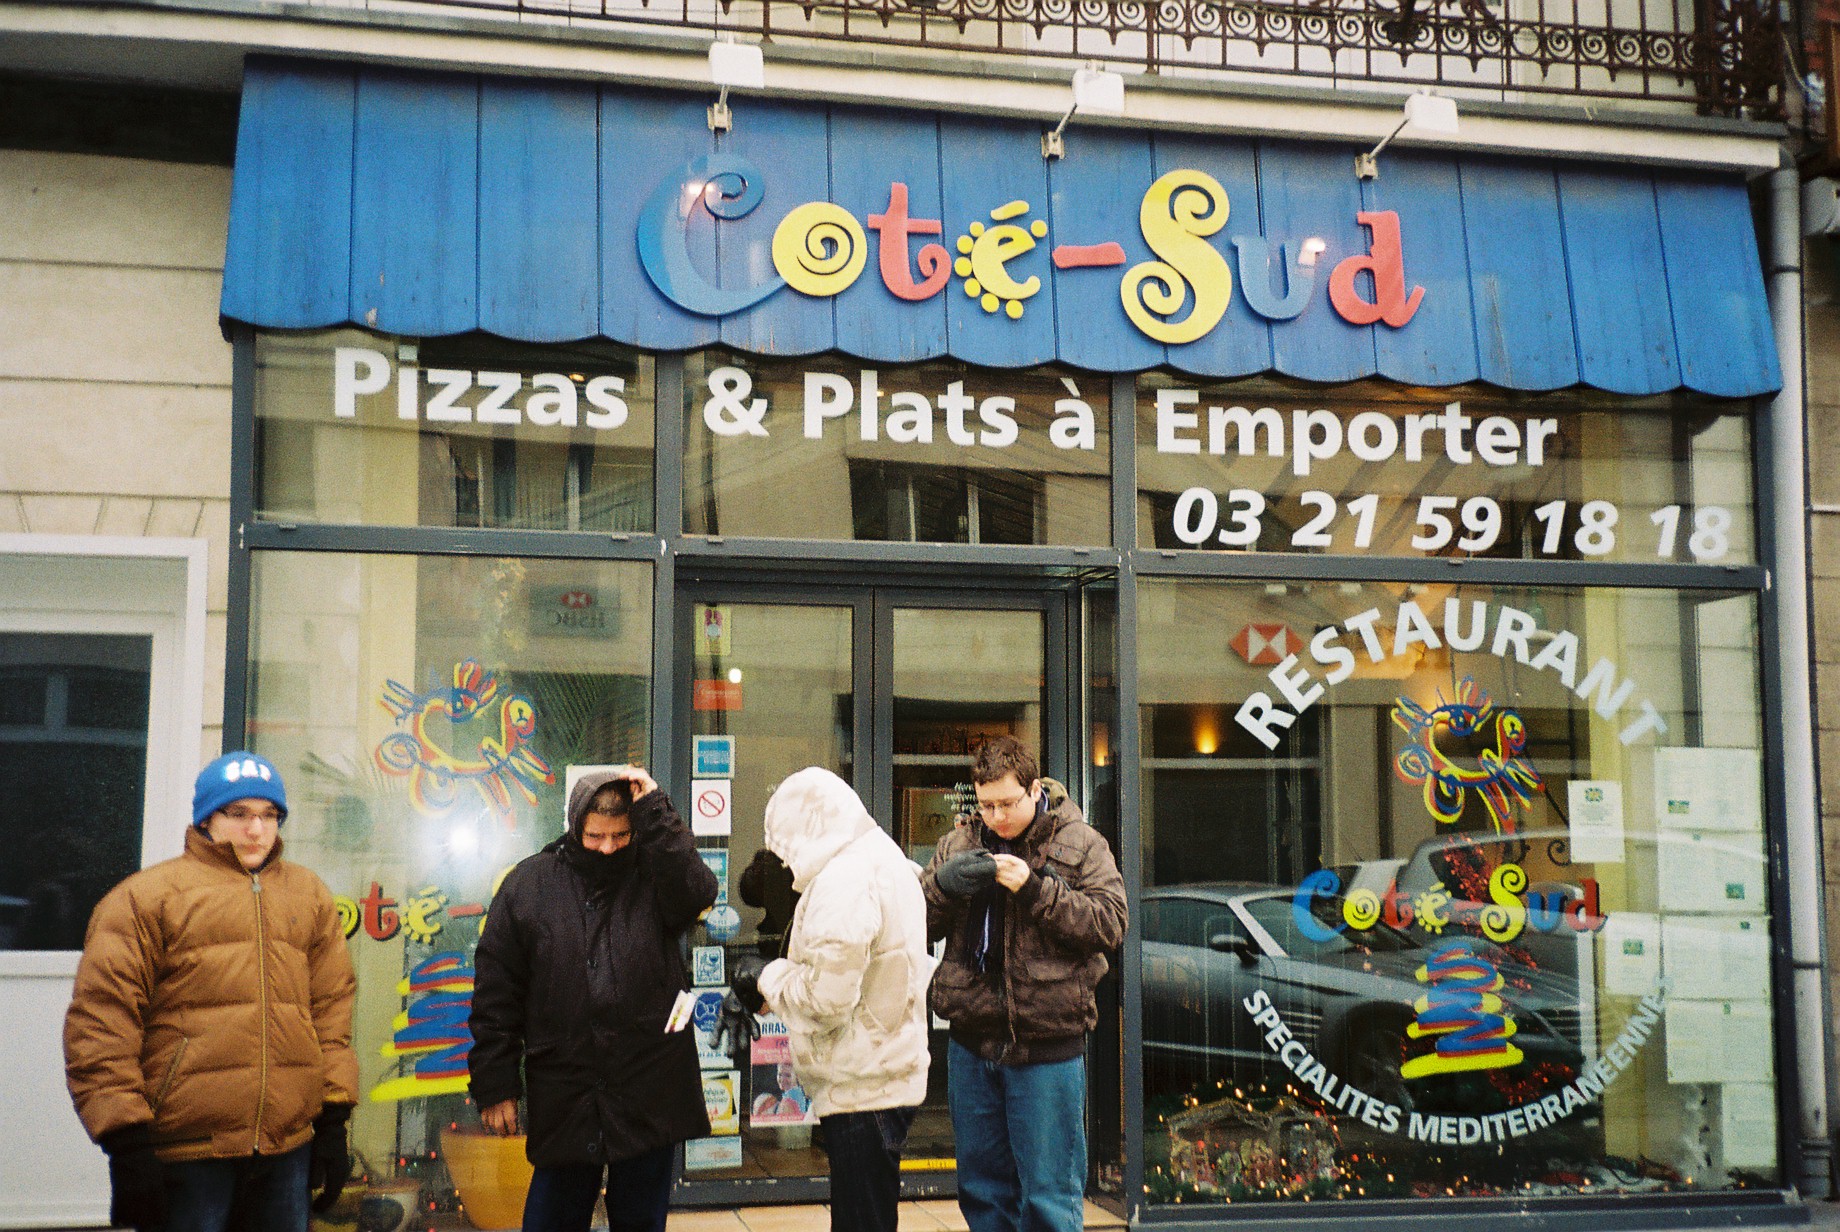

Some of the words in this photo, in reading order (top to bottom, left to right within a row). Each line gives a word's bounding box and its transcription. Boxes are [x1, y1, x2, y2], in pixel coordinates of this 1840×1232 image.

[637, 153, 1426, 345] Coté-Sud
[333, 346, 630, 431] Pizzas
[703, 367, 770, 437] &
[803, 370, 1018, 448] Plats
[1050, 379, 1096, 452] à
[1156, 389, 1559, 477] Emporter
[1173, 487, 1266, 546] 03
[1291, 491, 1380, 549] 21
[1411, 496, 1503, 553] 59
[1533, 500, 1620, 556] 18
[1649, 504, 1733, 562] 18
[1233, 597, 1668, 751] RESTAURANT
[1243, 988, 1402, 1133] SPECIALITES
